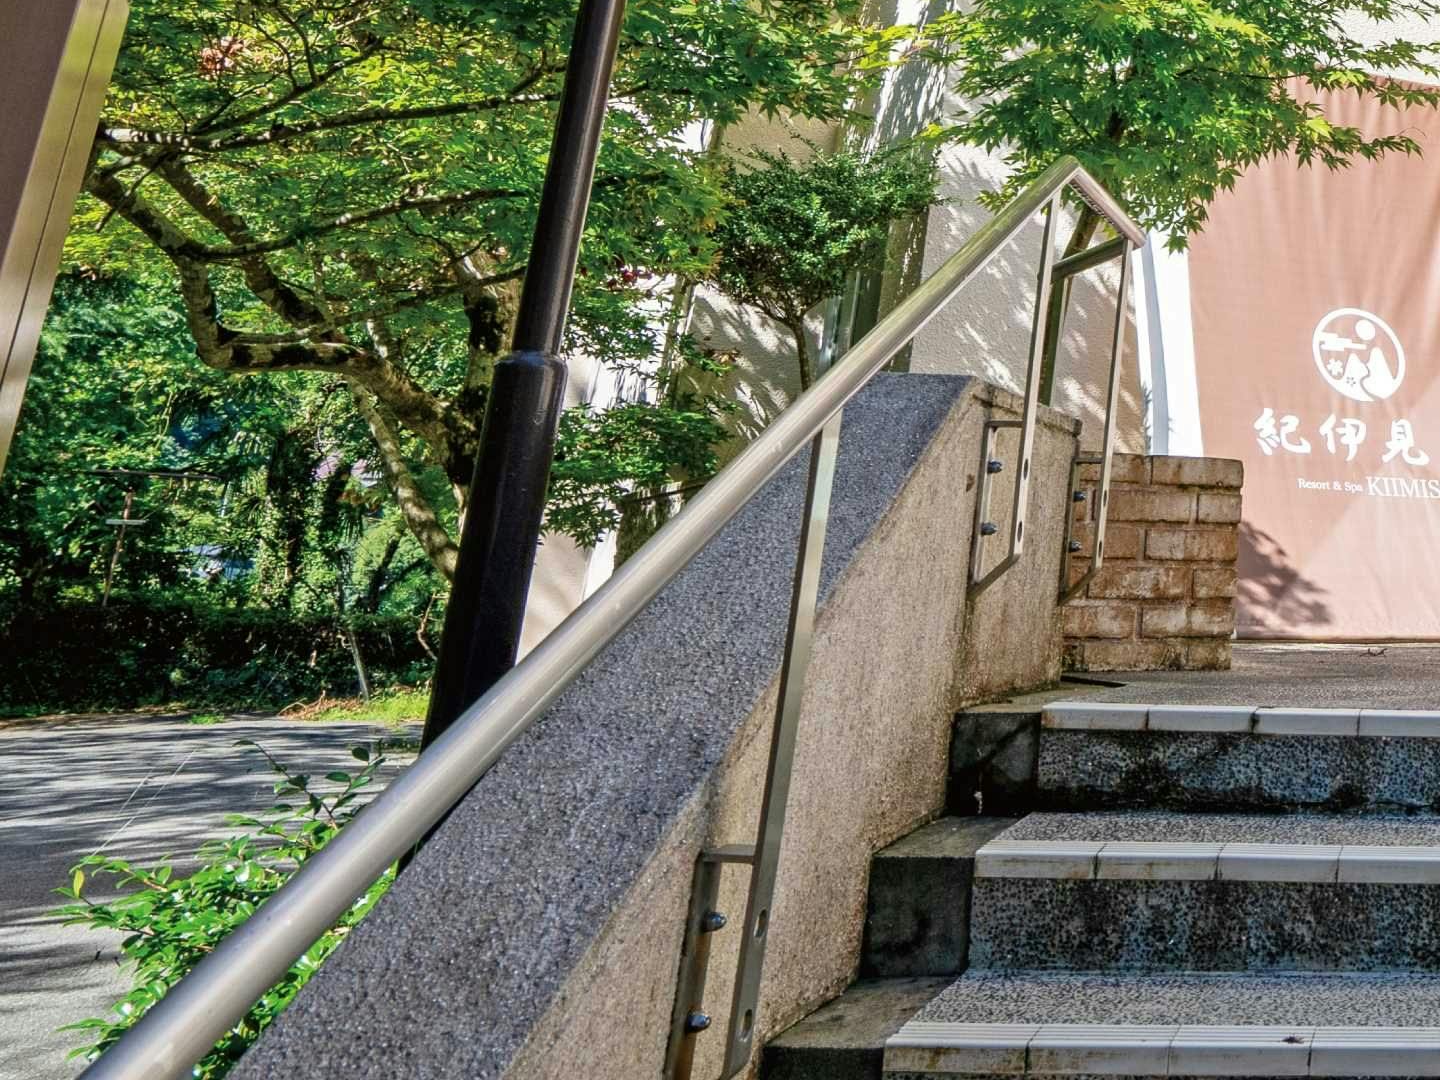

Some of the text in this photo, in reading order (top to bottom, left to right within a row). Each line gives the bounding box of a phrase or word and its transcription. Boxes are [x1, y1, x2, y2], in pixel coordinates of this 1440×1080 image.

[1298, 478, 1330, 491] Resort
[1333, 480, 1342, 491] &
[1344, 480, 1363, 493] Spa
